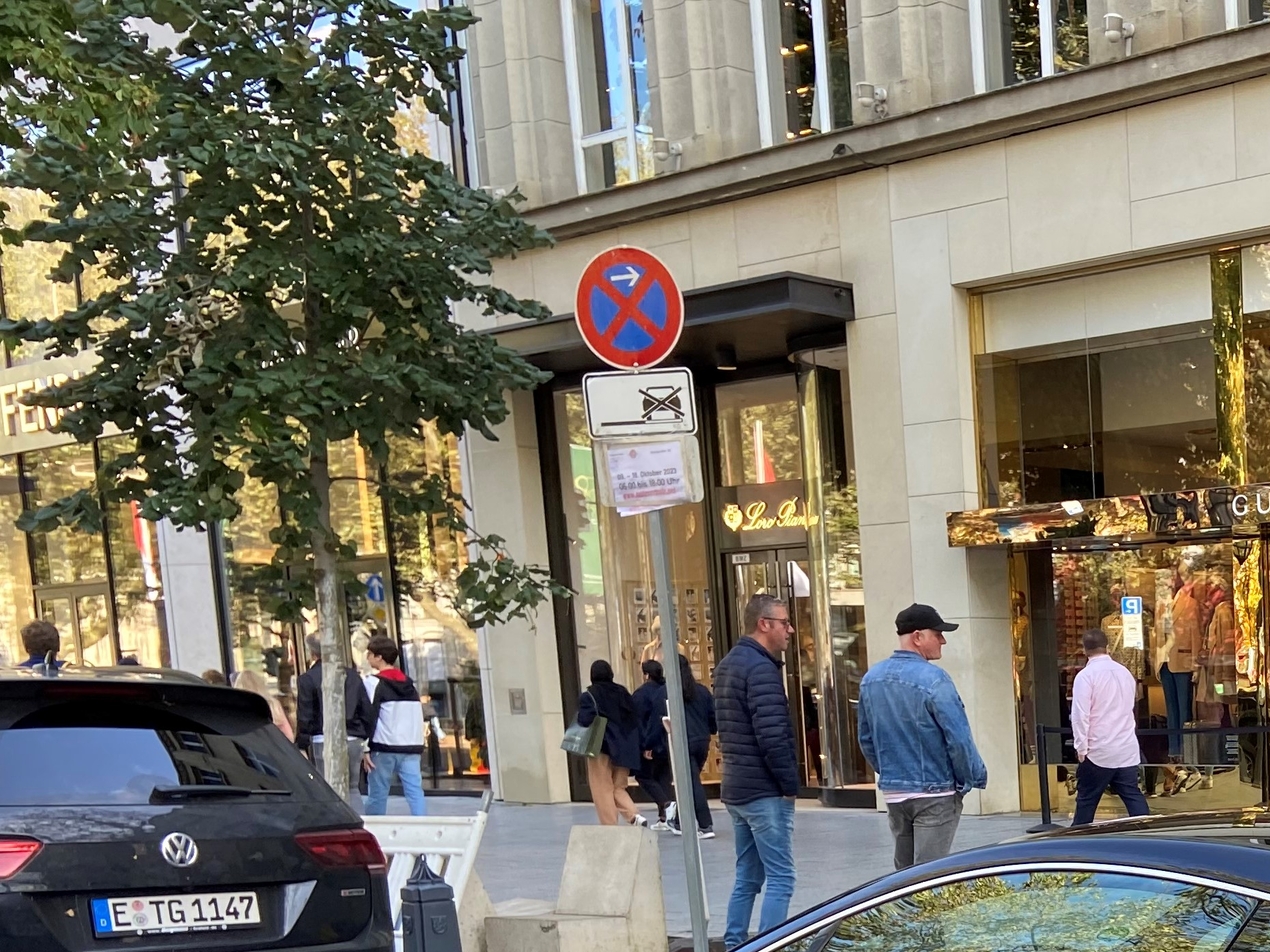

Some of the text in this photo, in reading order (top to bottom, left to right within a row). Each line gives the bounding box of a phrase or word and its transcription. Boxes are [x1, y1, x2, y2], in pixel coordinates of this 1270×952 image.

[640, 470, 661, 478] Oktober
[742, 501, 777, 531] Loro
[112, 896, 254, 926] E TG 1147
